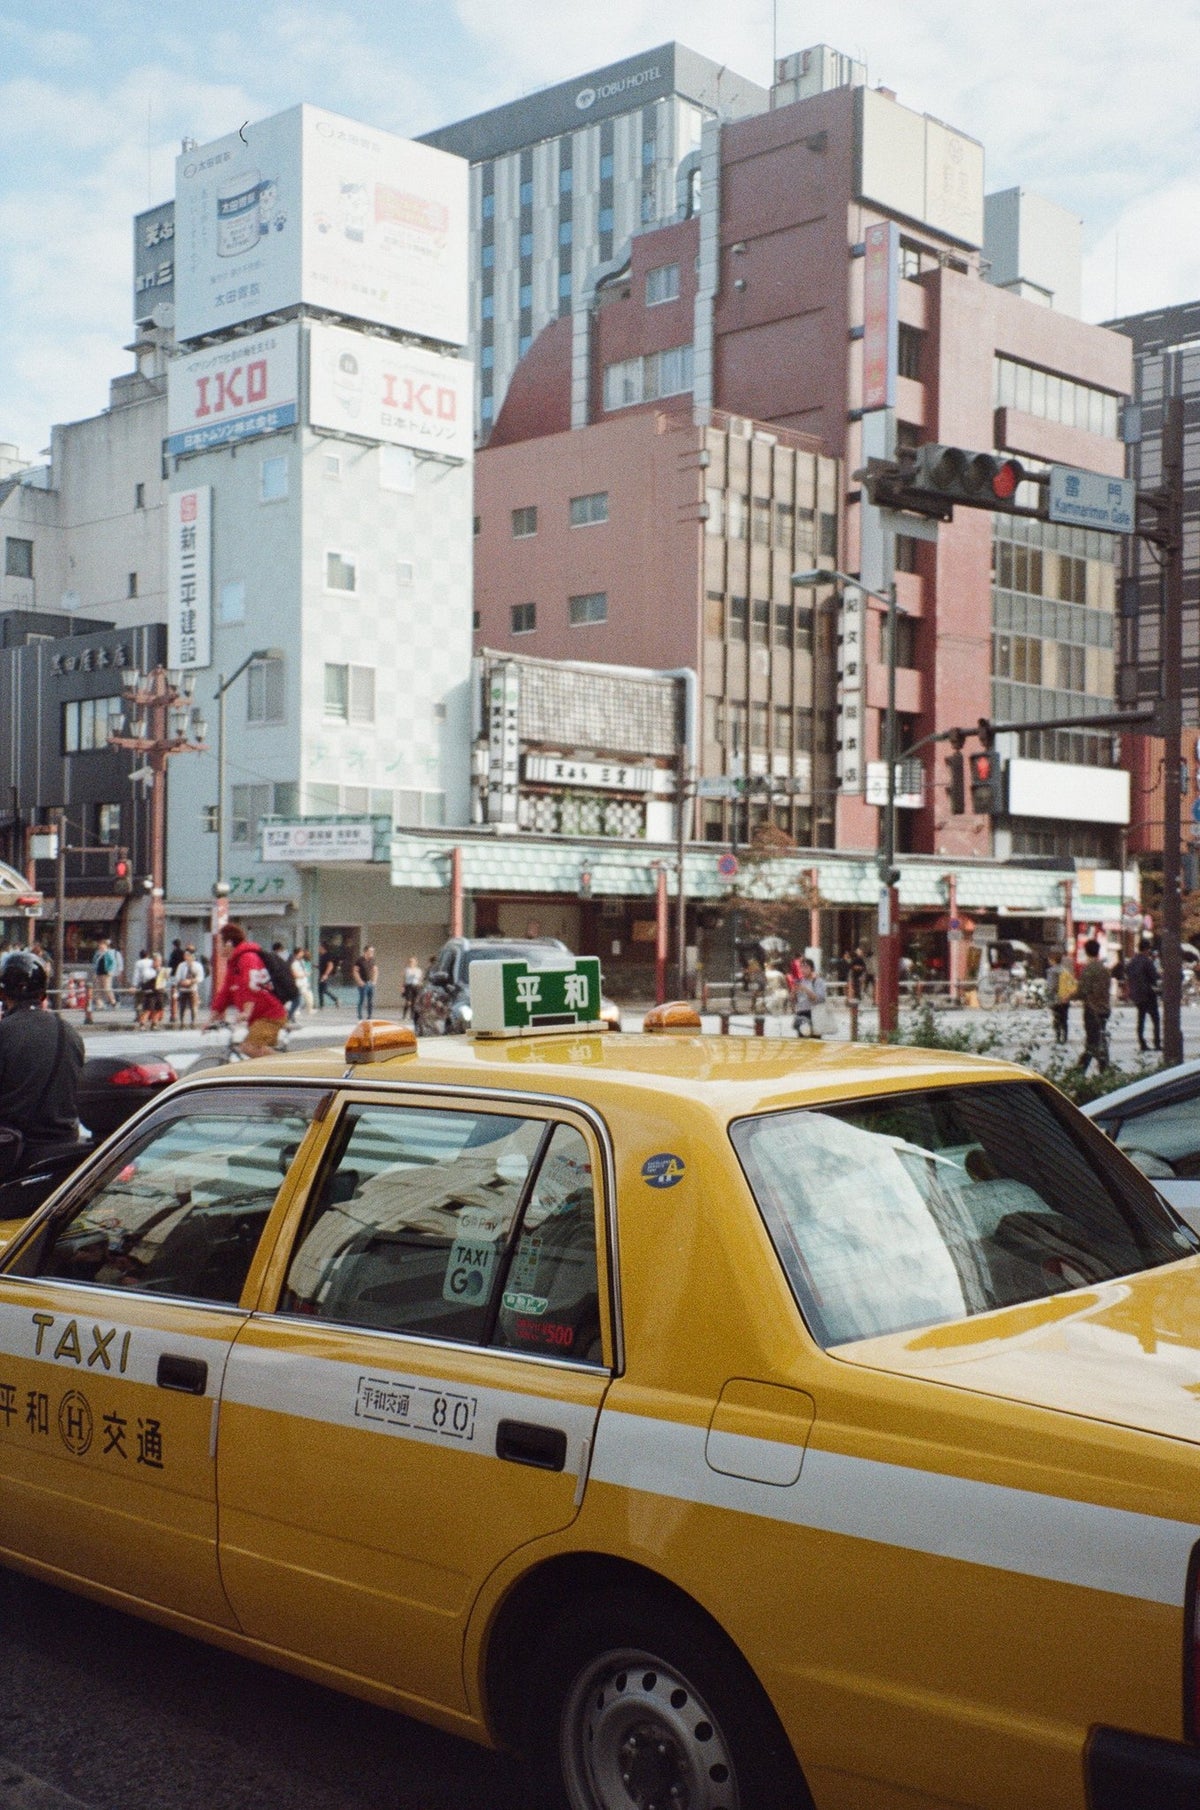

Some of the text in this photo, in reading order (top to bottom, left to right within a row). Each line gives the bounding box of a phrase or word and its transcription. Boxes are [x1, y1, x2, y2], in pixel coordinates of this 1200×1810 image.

[596, 67, 661, 99] TOBU HOTEL
[195, 359, 268, 418] IKO
[381, 373, 457, 422] IKO
[380, 412, 457, 440] 日本トムソン
[516, 973, 589, 1012] 平和
[478, 1217, 498, 1234] Pay
[457, 1246, 489, 1267] TAXI
[32, 1312, 131, 1374] TAXI
[0, 1382, 49, 1435] 平和
[103, 1411, 164, 1469] 交通
[362, 1387, 469, 1432] 平和交通 80
